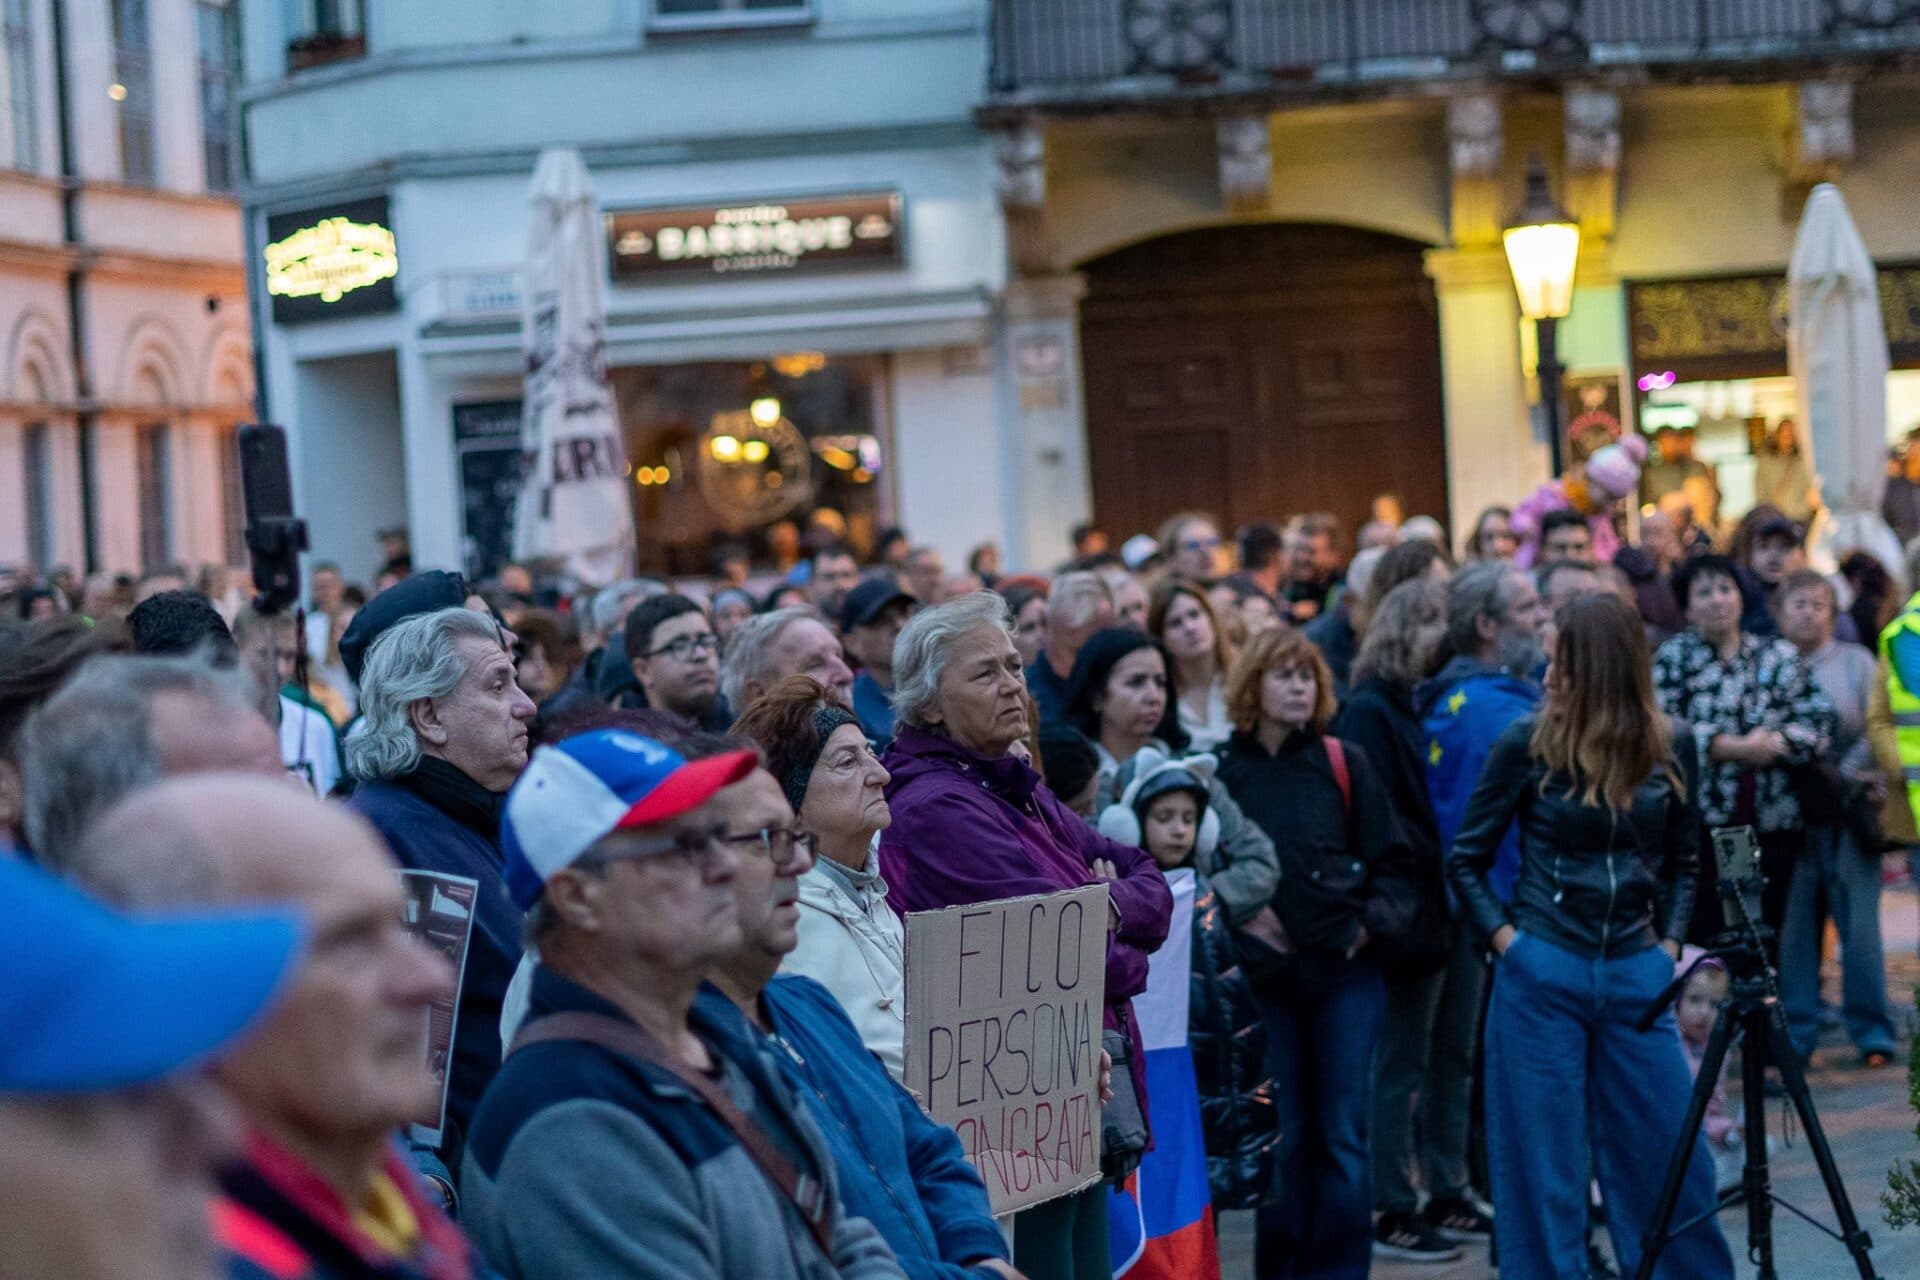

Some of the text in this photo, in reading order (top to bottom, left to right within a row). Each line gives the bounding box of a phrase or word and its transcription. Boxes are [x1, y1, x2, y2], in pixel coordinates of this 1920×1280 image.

[656, 215, 852, 260] BARRIQUE
[957, 900, 1083, 1007] FICO
[927, 999, 1093, 1111] PERSONA
